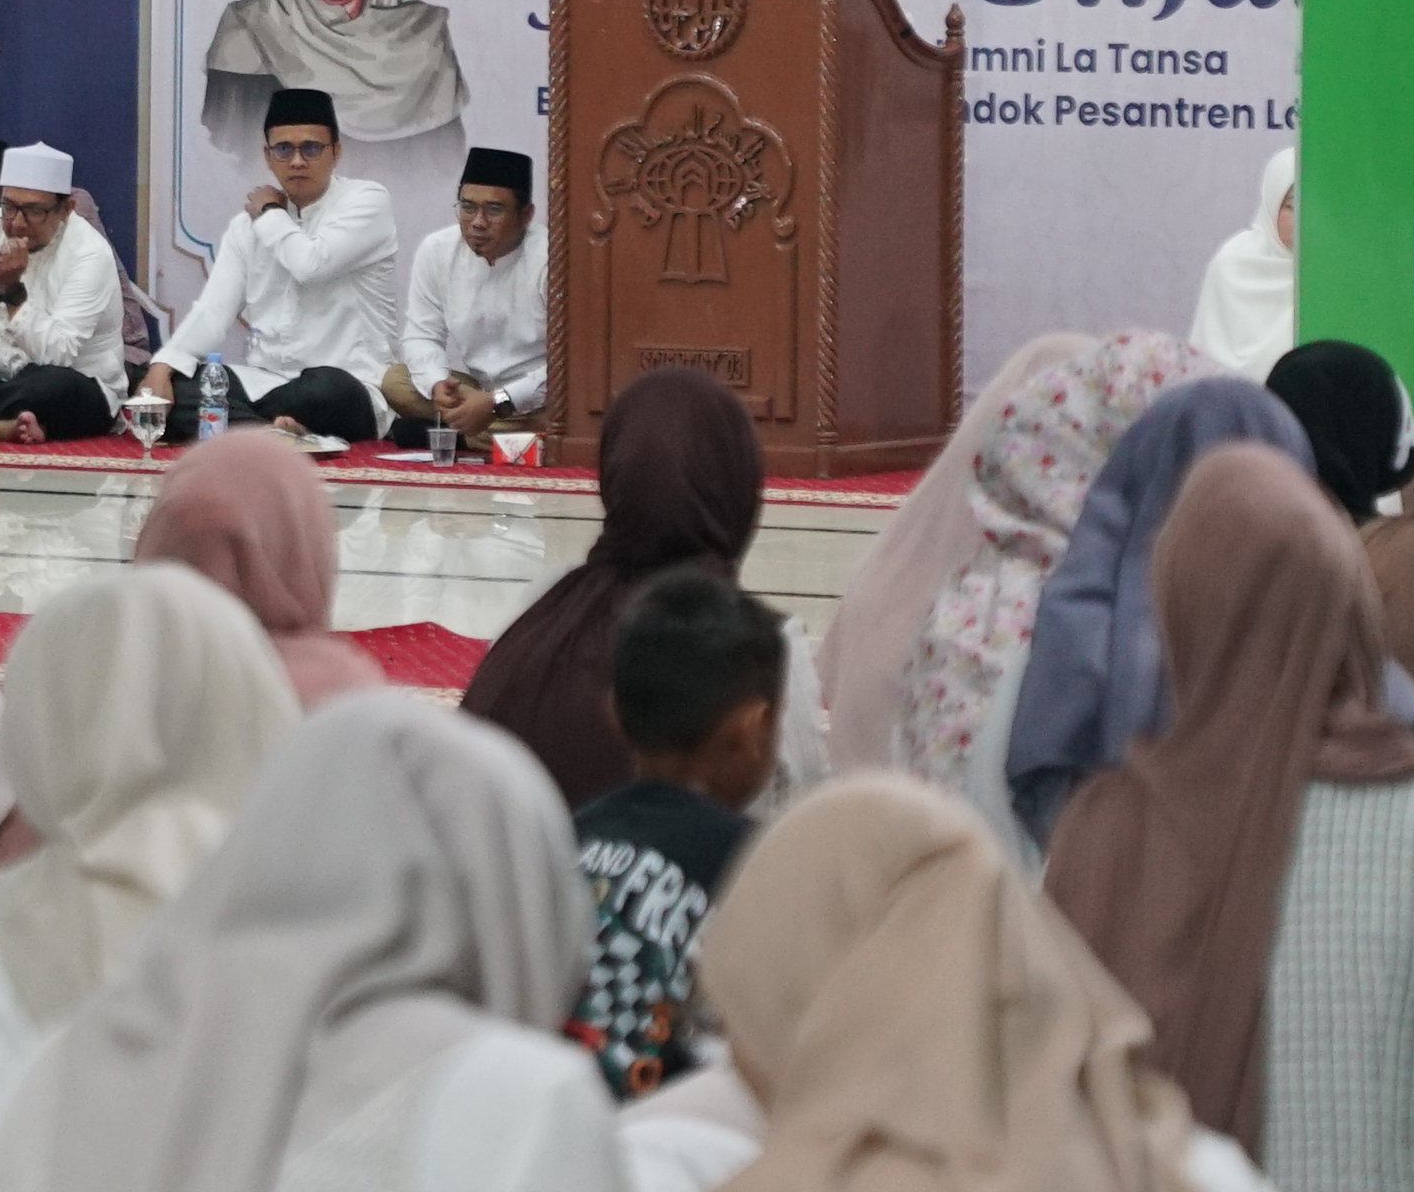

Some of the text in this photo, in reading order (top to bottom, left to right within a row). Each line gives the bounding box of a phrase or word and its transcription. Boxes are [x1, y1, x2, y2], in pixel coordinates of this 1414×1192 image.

[1057, 42, 1097, 73] La
[1108, 43, 1229, 75] Tansa
[1055, 95, 1256, 130] Pesantren
